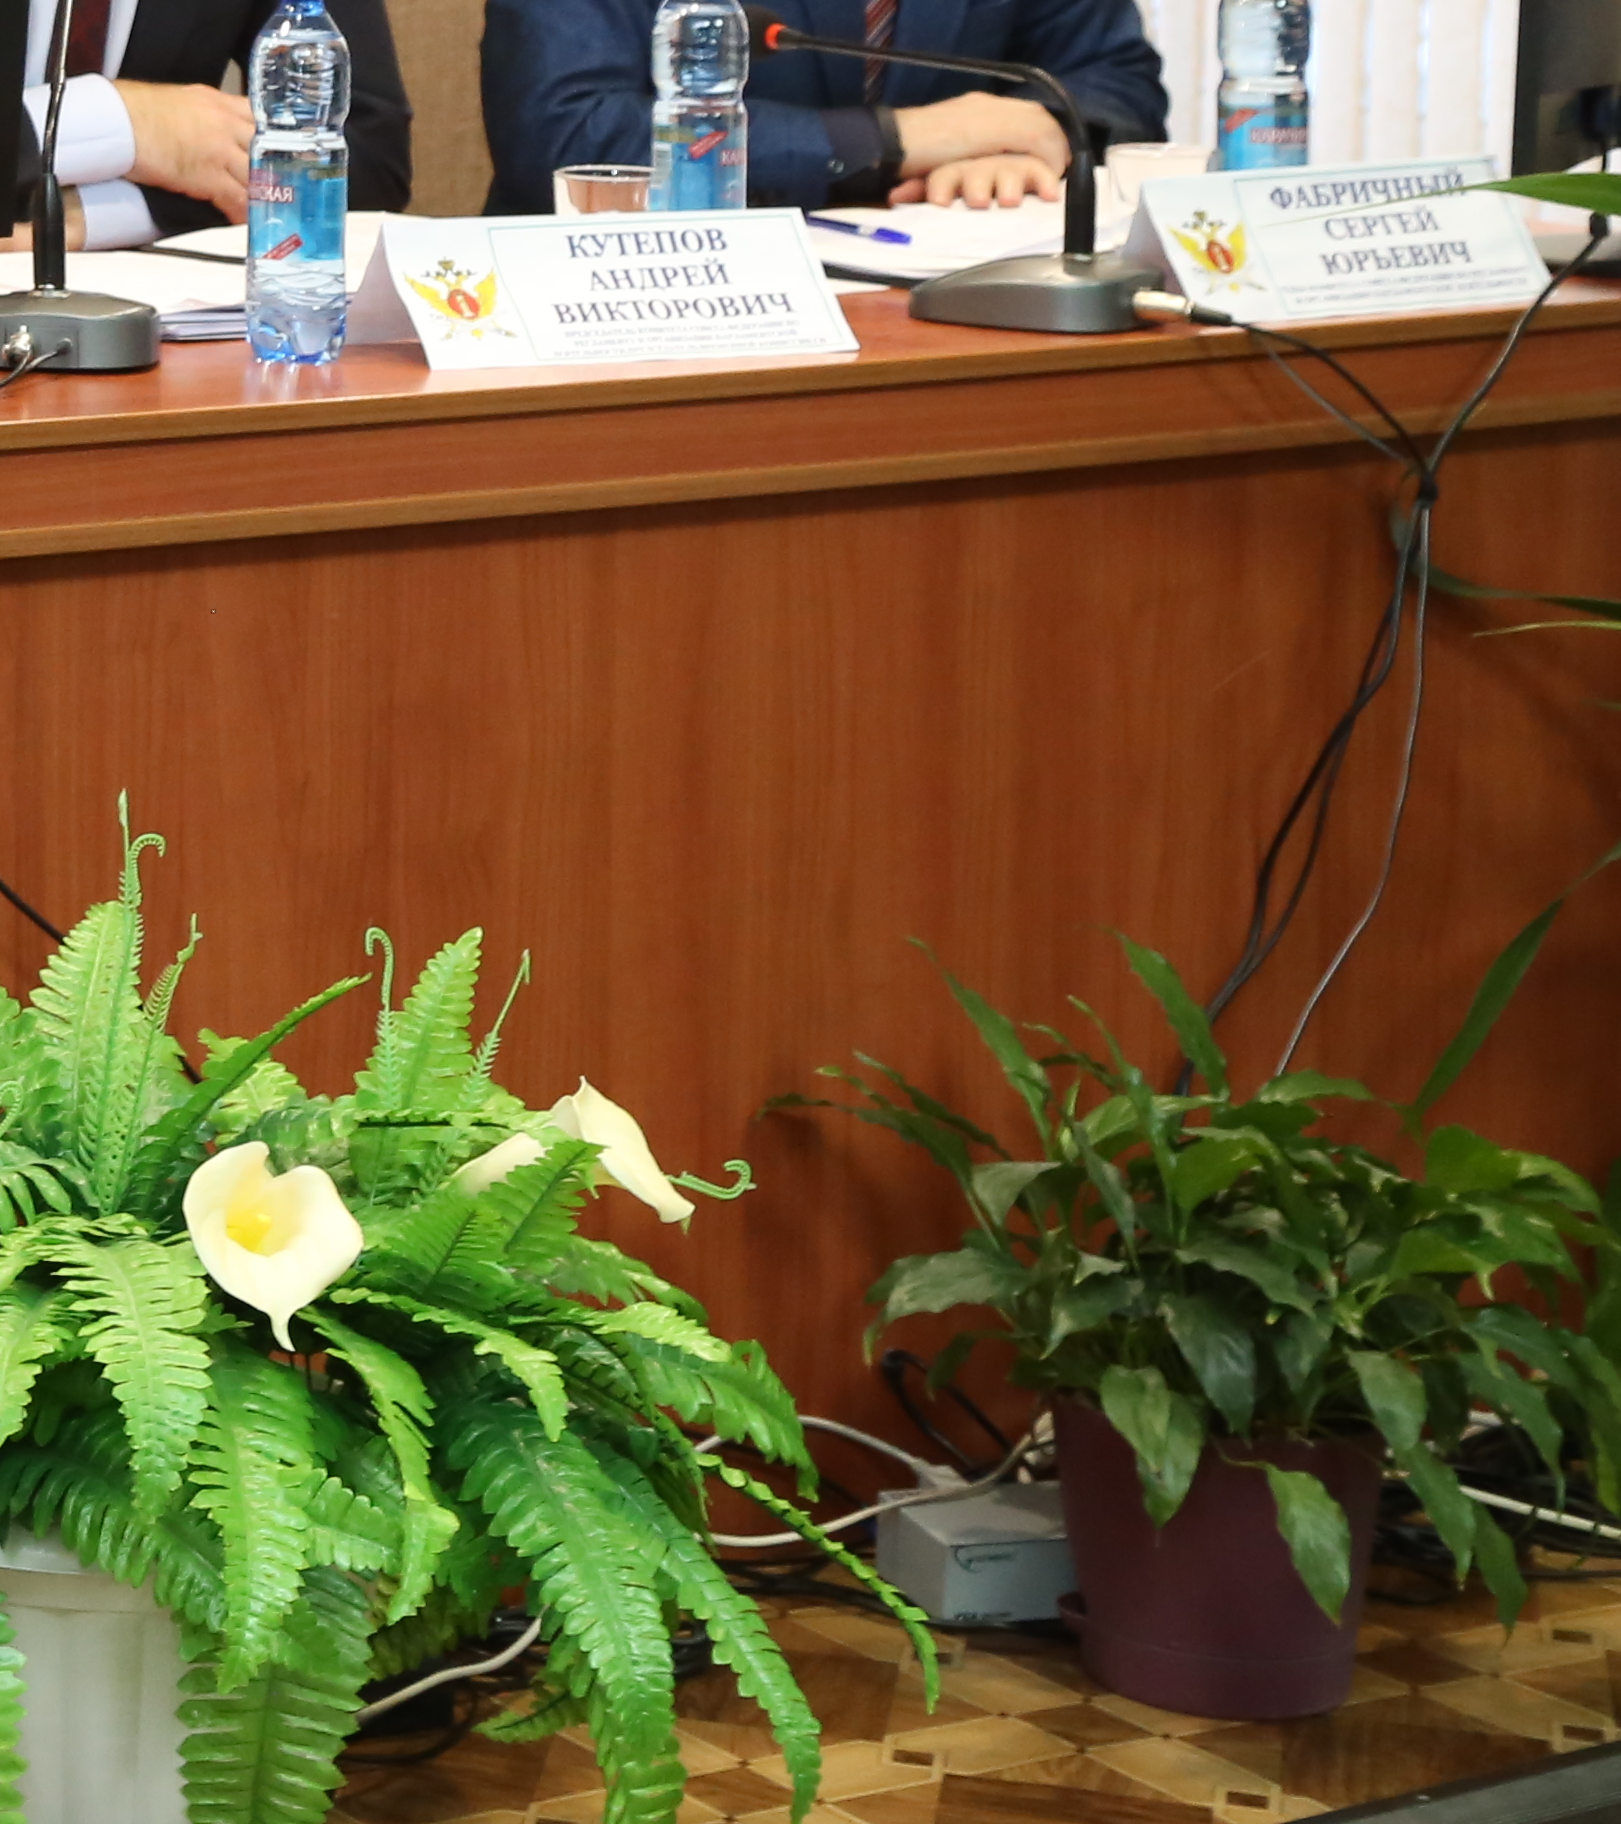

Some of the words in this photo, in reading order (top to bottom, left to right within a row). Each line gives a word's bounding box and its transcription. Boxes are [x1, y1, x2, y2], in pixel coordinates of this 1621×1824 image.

[1270, 166, 1466, 210] ФАБРИЧНЫЙ
[1324, 205, 1441, 241] СЕРГЕЙ
[565, 228, 728, 259] КУТЕПОВ
[1320, 241, 1473, 275] ЮРЬЕВИЧ
[589, 256, 733, 292] АНДРЕЙ
[551, 292, 796, 325] ВИКТОРОВИЧ
